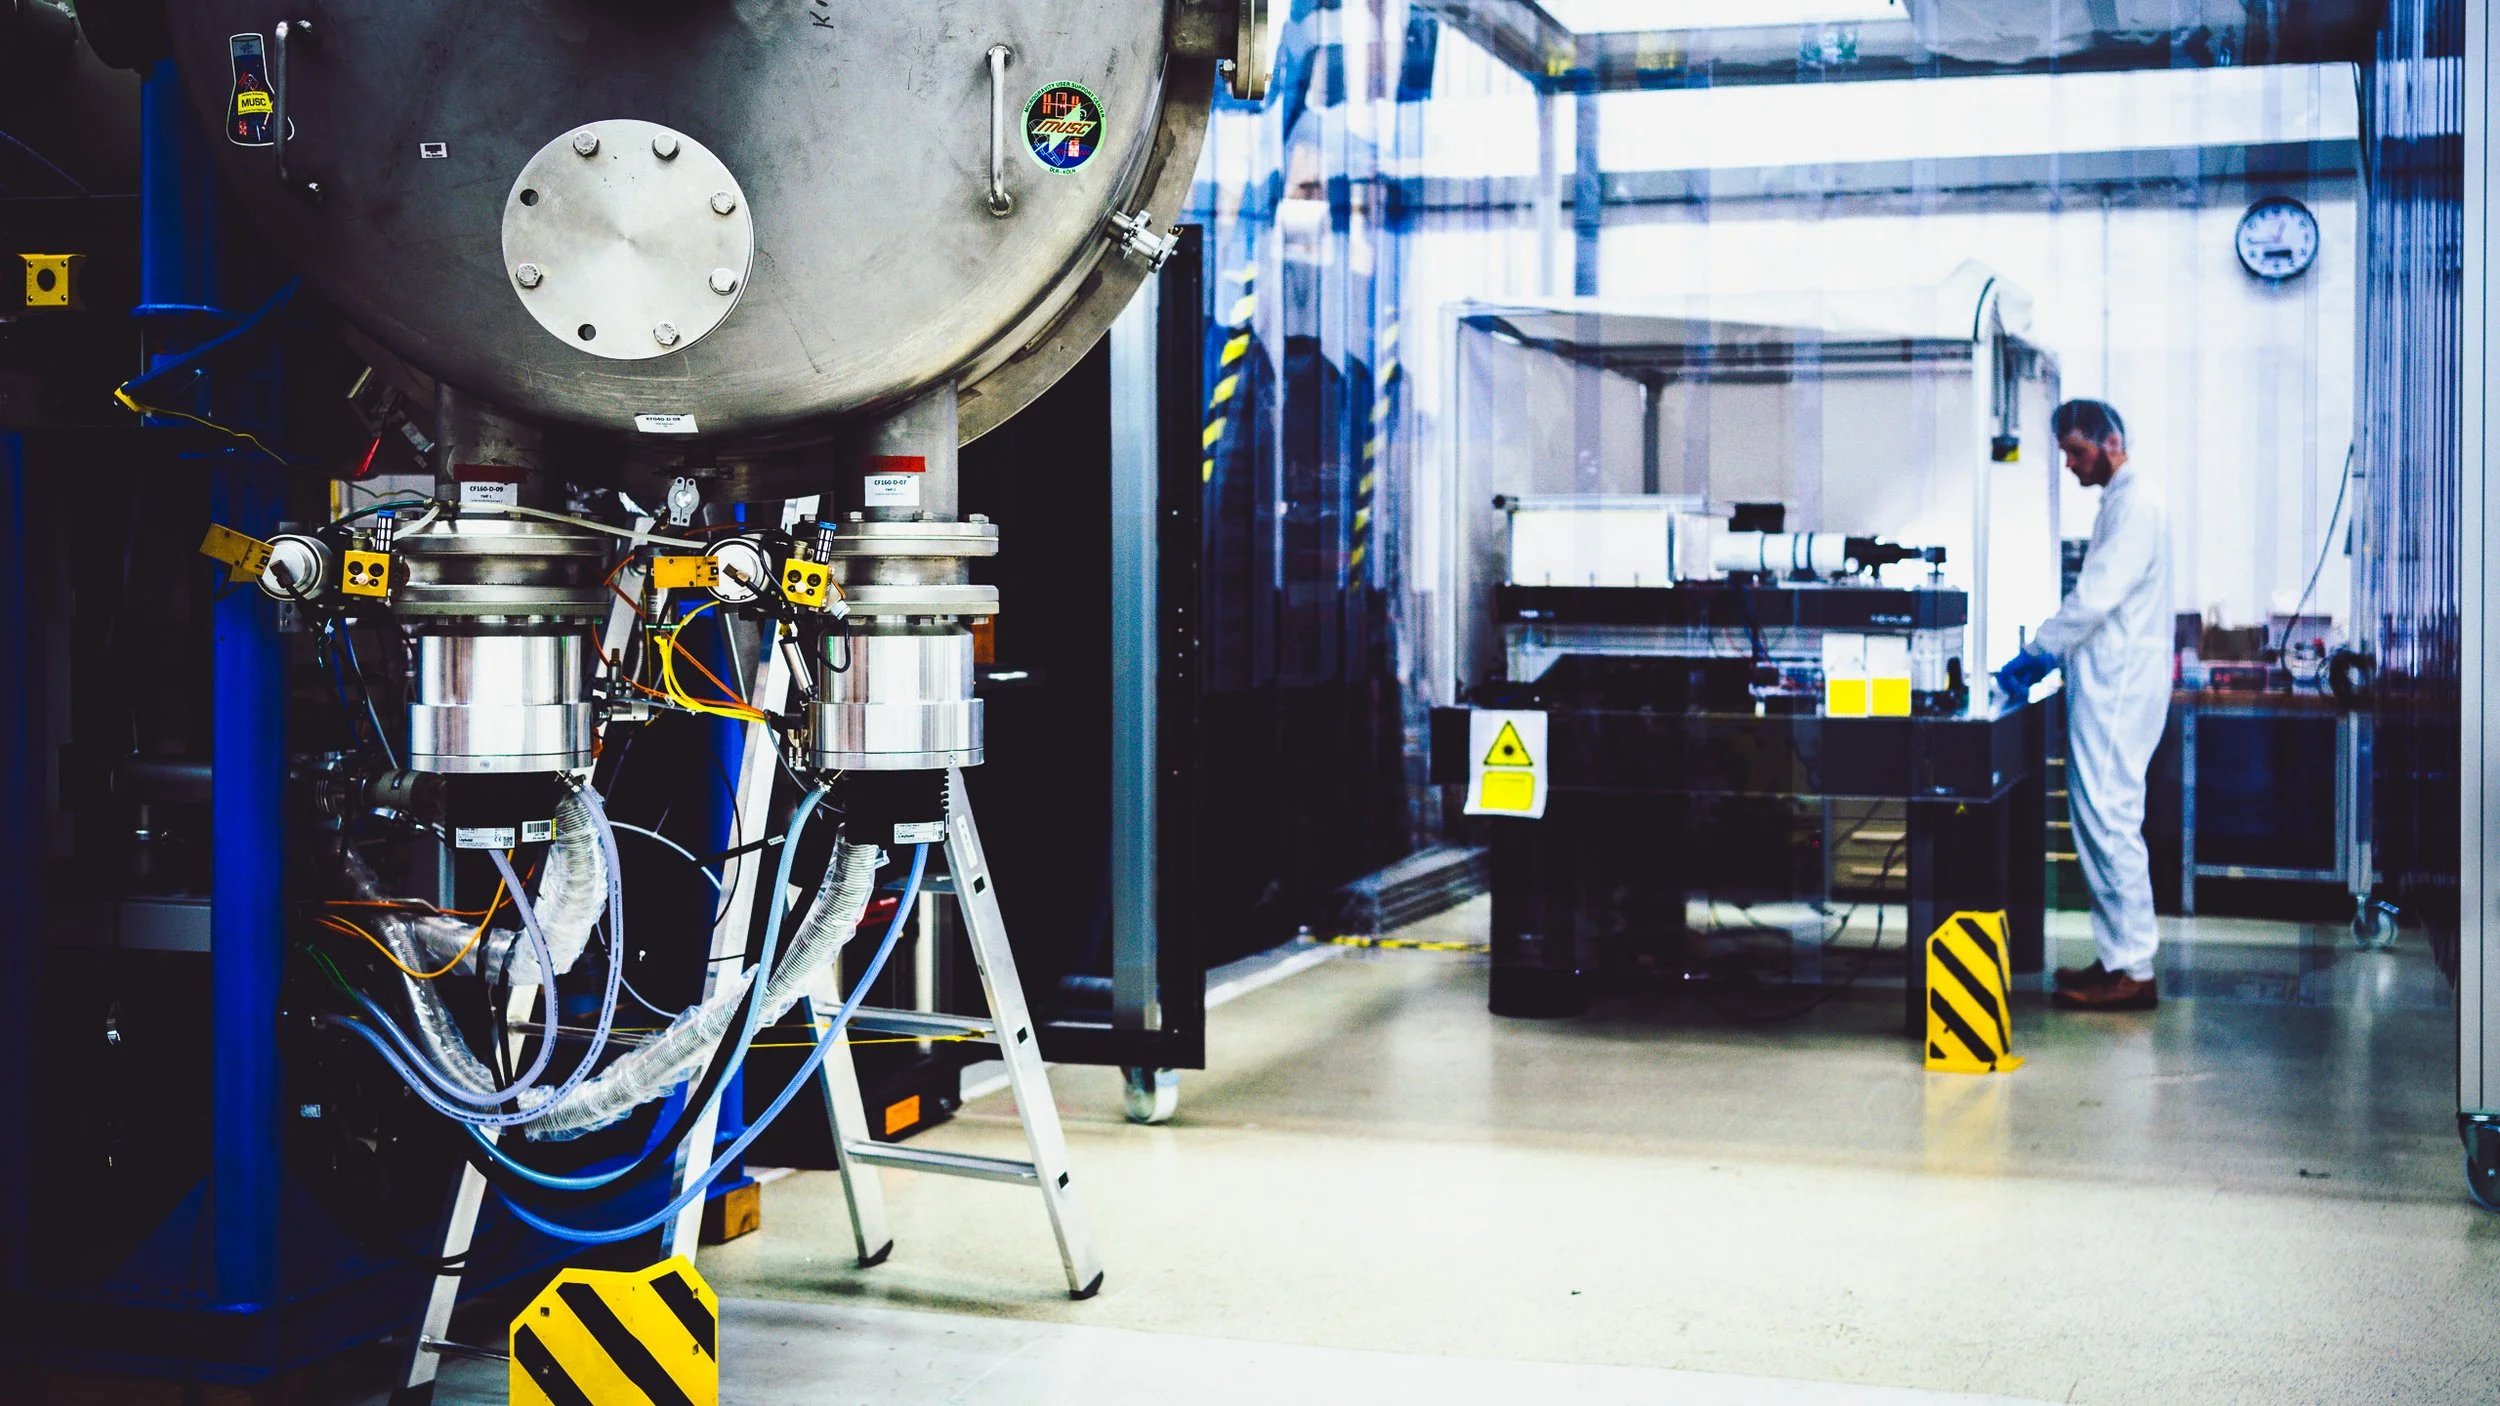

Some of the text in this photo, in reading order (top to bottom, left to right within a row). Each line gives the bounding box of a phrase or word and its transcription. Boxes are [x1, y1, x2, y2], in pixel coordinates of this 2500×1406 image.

[241, 97, 267, 108] MUSC
[1024, 83, 1055, 112] MICROGRAVITY
[1071, 82, 1094, 98] SUPPORT
[1093, 97, 1105, 118] CENTER
